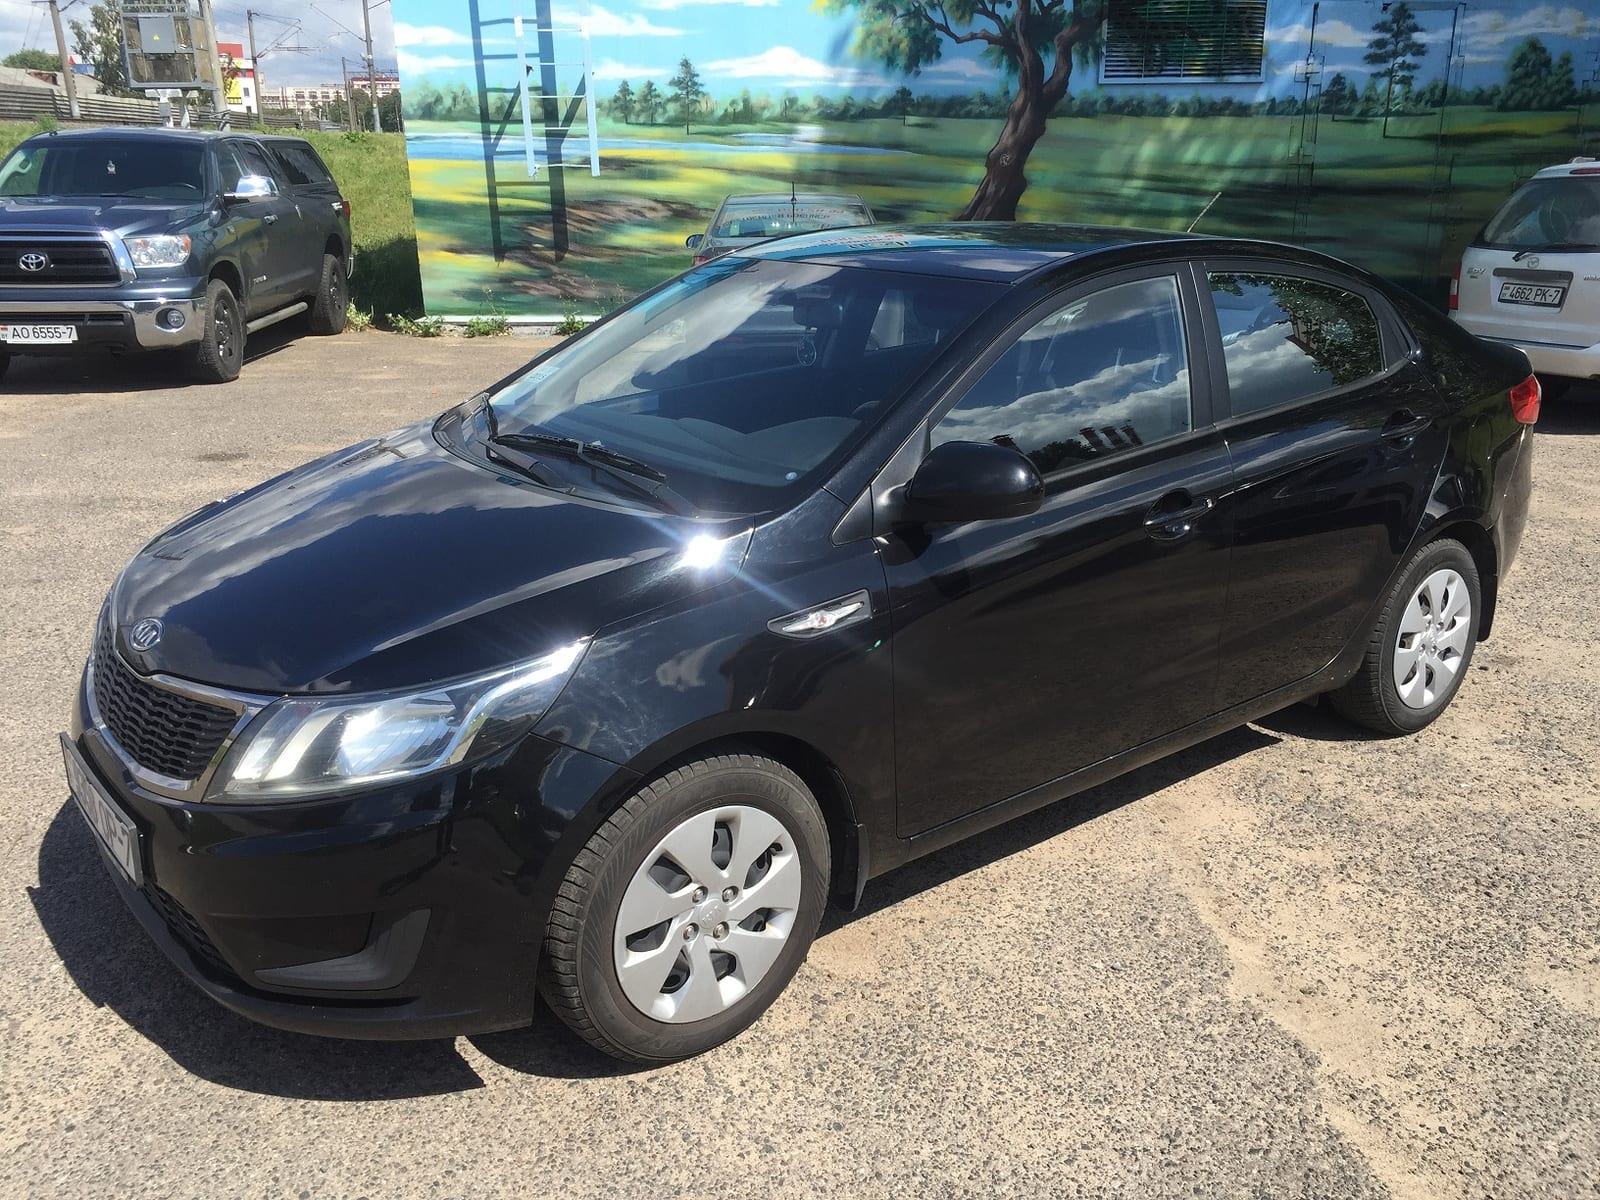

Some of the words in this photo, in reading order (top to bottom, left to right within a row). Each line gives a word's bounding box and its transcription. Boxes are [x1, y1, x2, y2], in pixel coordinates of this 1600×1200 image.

[1509, 286, 1533, 301] 4662
[1534, 288, 1560, 303] PK-7
[12, 326, 30, 339] AO
[32, 326, 74, 339] 6555-7
